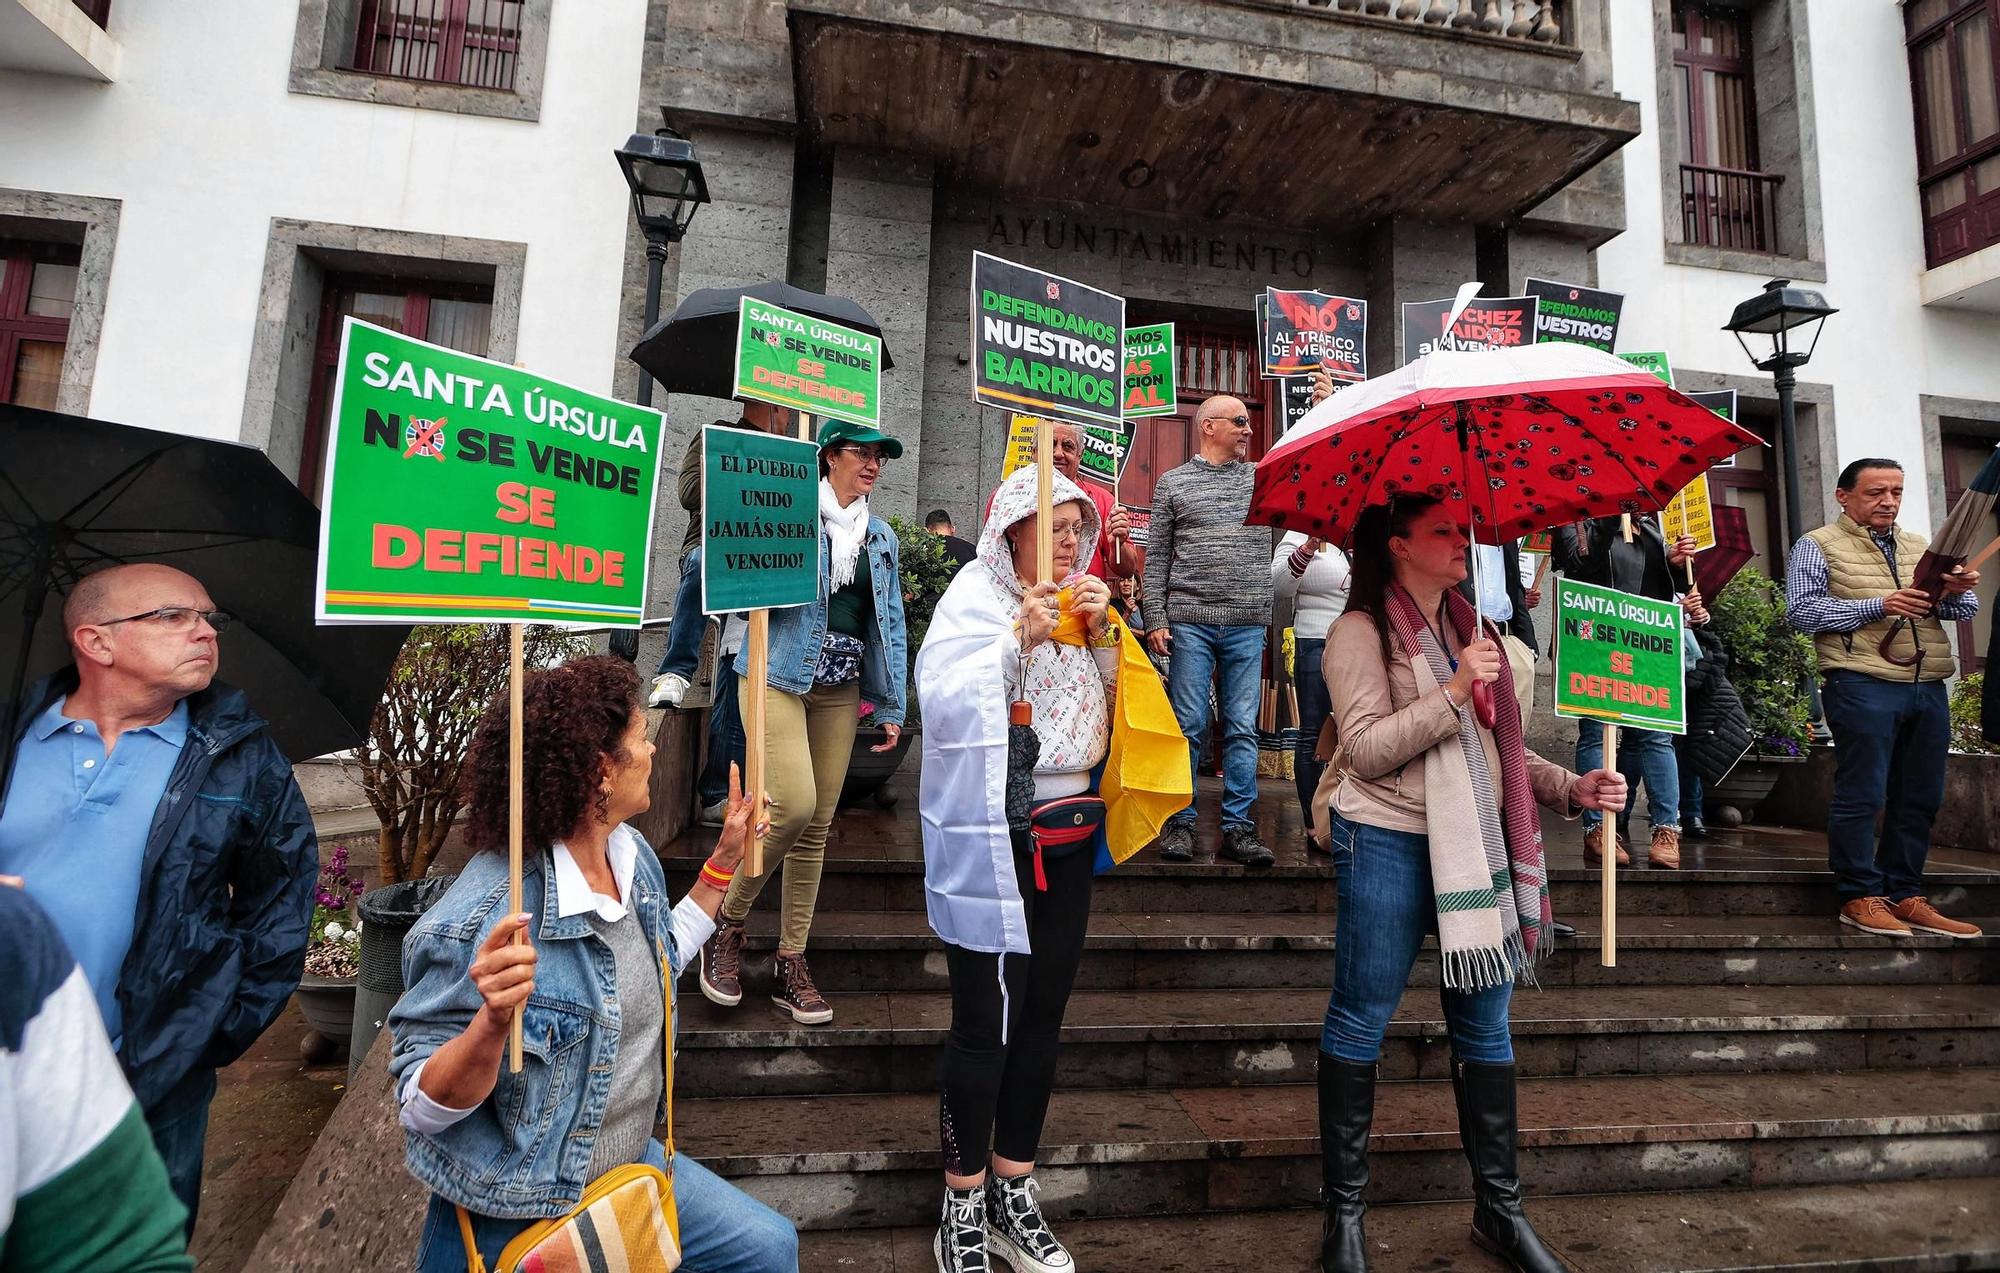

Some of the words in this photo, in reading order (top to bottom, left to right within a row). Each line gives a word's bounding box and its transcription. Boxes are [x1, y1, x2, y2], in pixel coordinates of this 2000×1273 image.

[988, 214, 1316, 278] AYUNTAMIENTO
[982, 289, 1117, 345] DEFENDAMOS
[1294, 305, 1338, 333] NO
[1539, 299, 1616, 323] EFENDAMOS
[749, 307, 806, 336] SANTA
[810, 323, 874, 355] ÚRSULA
[1124, 330, 1162, 346] AMOS
[1275, 331, 1294, 345] AL
[1298, 330, 1355, 351] TRÁFICO
[1538, 314, 1613, 341] UESTROS
[784, 337, 806, 355] SE
[811, 344, 872, 373] VENDE
[984, 315, 1116, 373] NUESTROS
[1124, 343, 1167, 359] RSULA
[1271, 344, 1291, 358] DE
[1298, 344, 1360, 365] MENORES
[796, 358, 826, 380] SE
[985, 350, 1115, 408] BARRIOS
[1125, 357, 1152, 376] ÁS
[752, 366, 867, 409] DEFIENDE
[1124, 374, 1164, 389] CION
[362, 351, 514, 418] SANTA
[524, 387, 648, 453] ÚRSULA
[1124, 385, 1167, 410] AL
[1082, 432, 1125, 458] STROS
[456, 428, 516, 468] SE
[526, 440, 641, 496] VENDE
[720, 455, 741, 473] EL
[746, 456, 809, 481] PUEBLO
[495, 481, 557, 529] SE
[741, 489, 793, 509] UNIDO
[709, 516, 774, 539] JAMÁS
[777, 519, 817, 539] SERÁ
[371, 522, 626, 588] DEFIENDE
[725, 553, 804, 570] VENCIDO!
[1562, 591, 1616, 617] SANTA
[1618, 599, 1675, 630] ÚRSULA
[1596, 624, 1617, 644] SE
[1620, 628, 1674, 655] VENDE
[1609, 650, 1634, 676] SE
[1569, 672, 1671, 709] DEFIENDE
